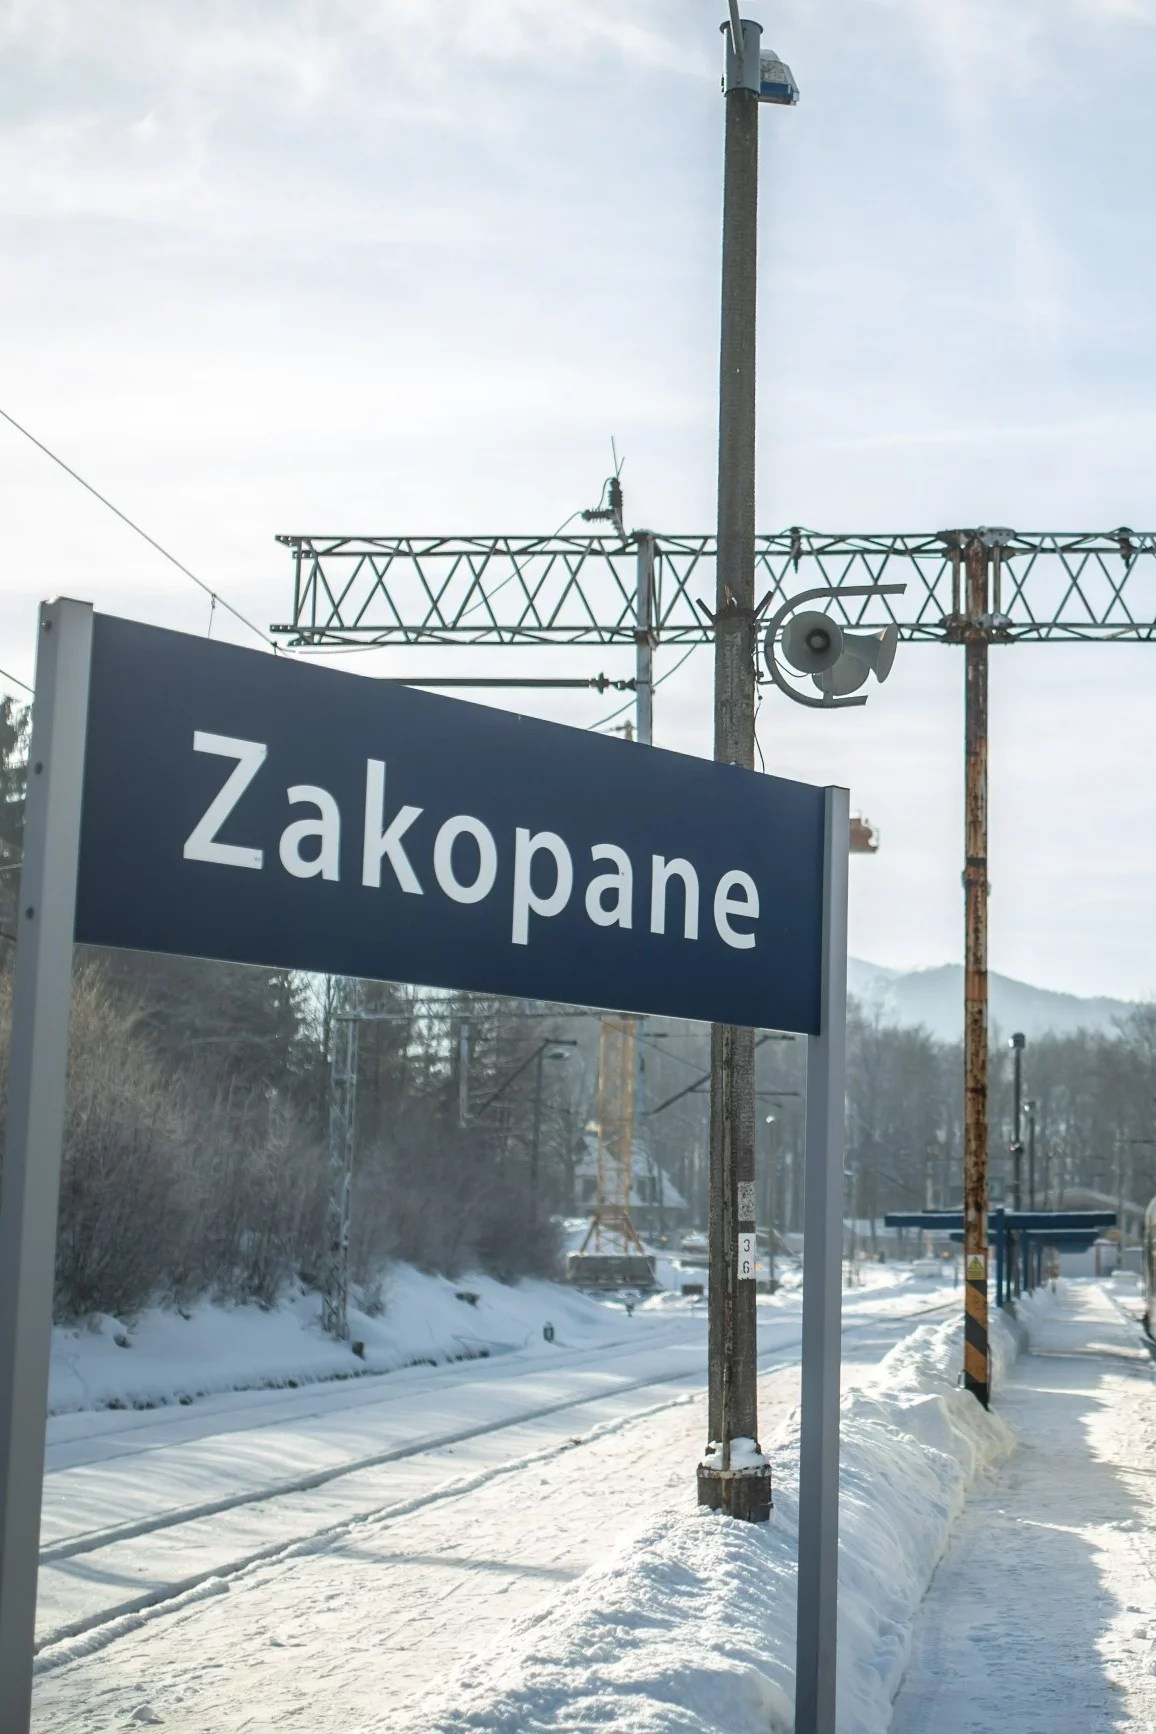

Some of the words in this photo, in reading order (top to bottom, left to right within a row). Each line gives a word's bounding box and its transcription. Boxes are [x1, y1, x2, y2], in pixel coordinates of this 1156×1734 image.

[184, 731, 761, 949] Zakopane
[743, 1239, 751, 1252] 3
[742, 1261, 750, 1274] 6
